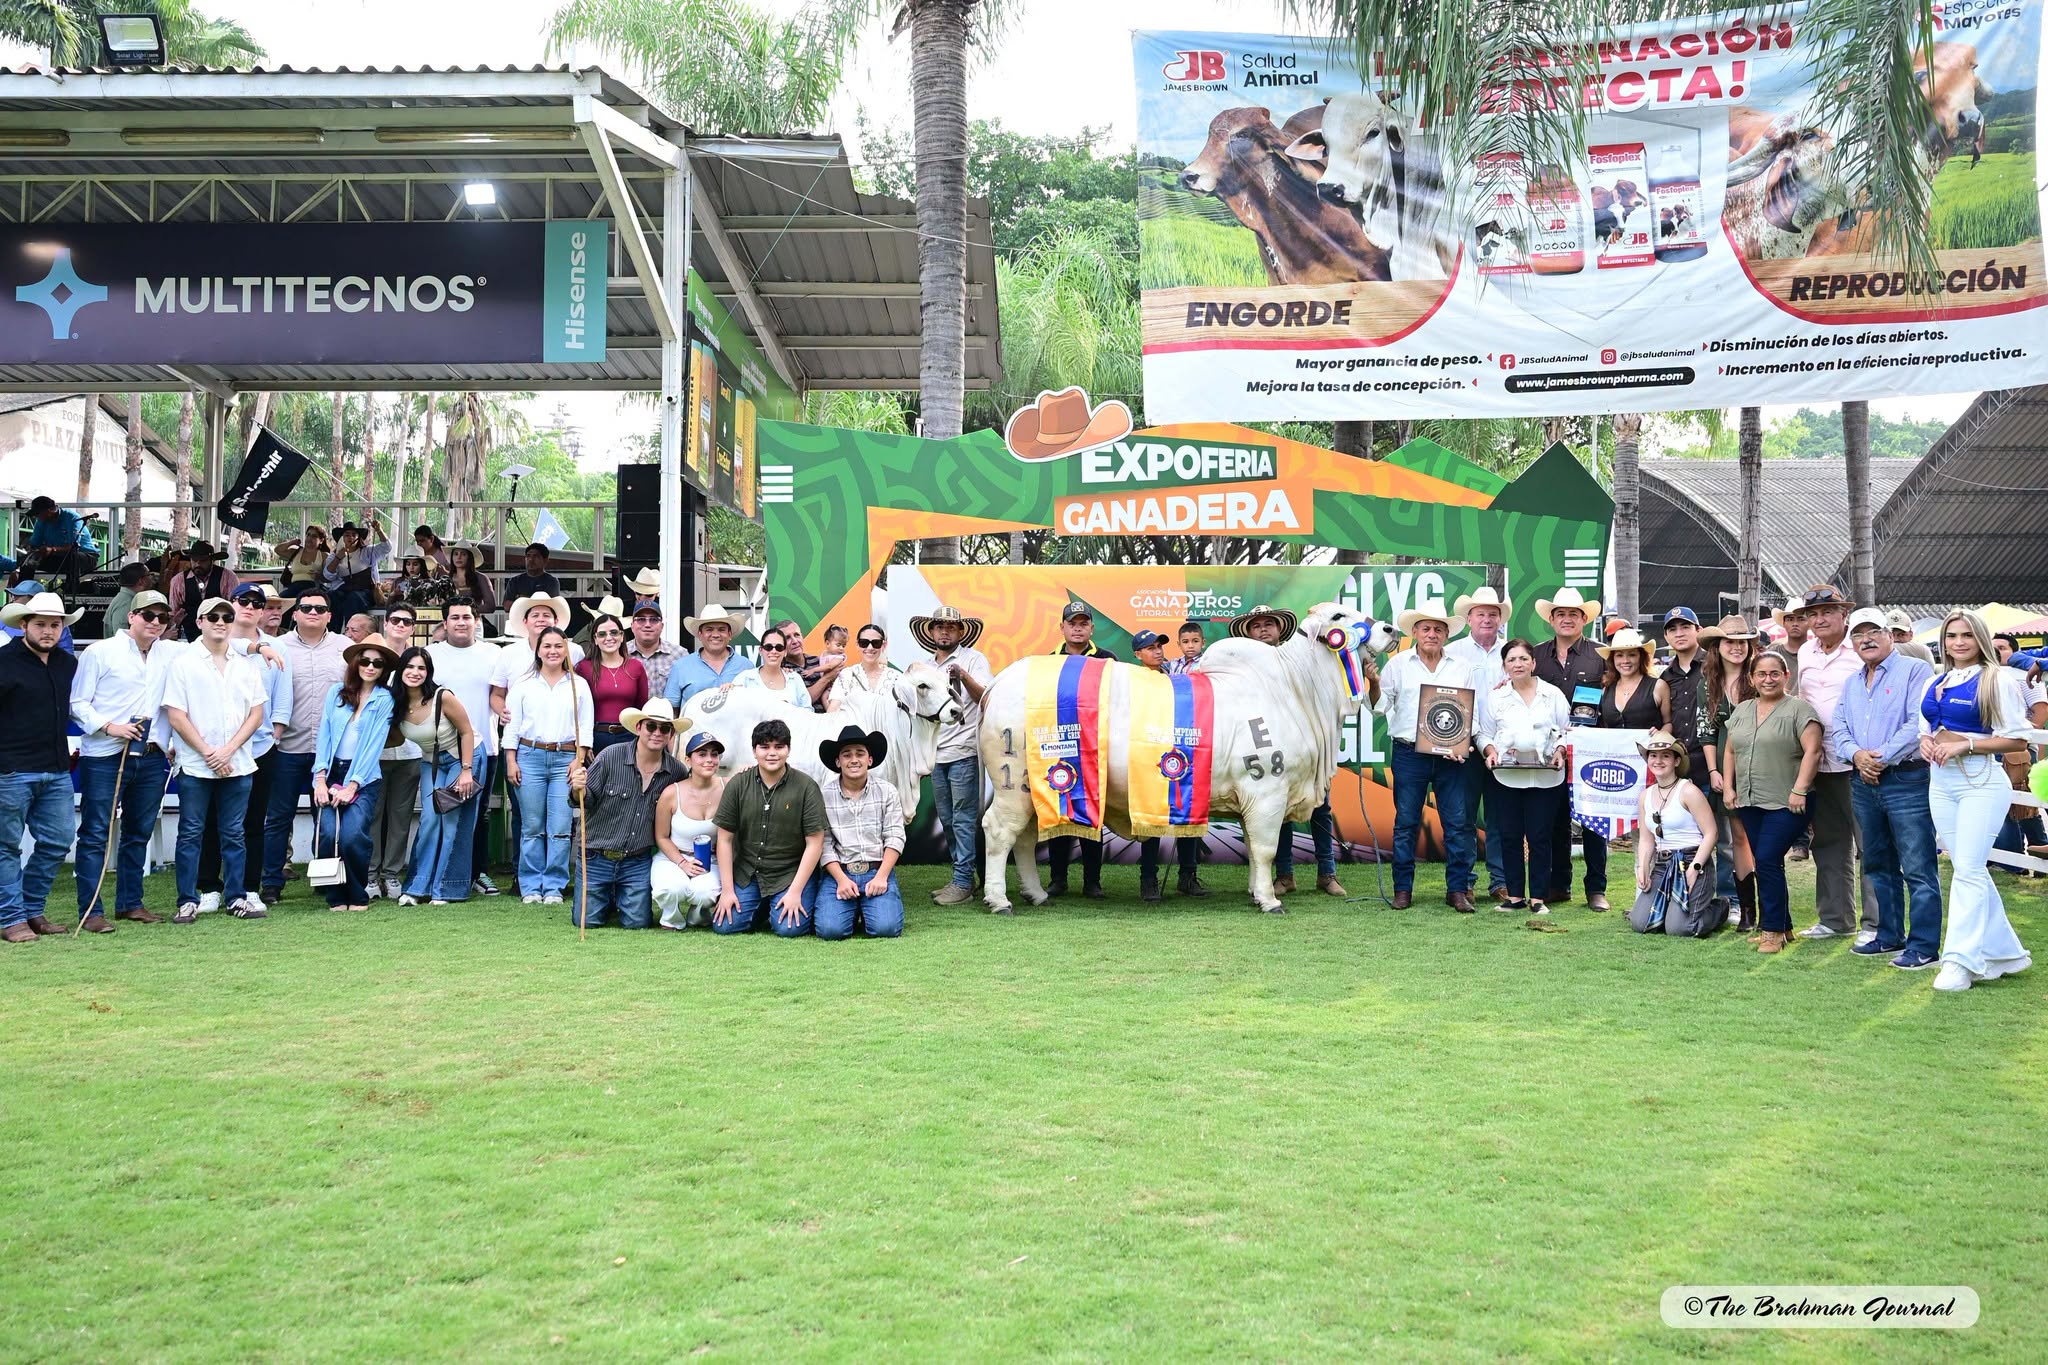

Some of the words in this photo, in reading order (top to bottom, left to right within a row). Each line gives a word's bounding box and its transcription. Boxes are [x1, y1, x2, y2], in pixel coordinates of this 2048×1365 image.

[1944, 7, 2021, 30] Mayores
[1242, 53, 1296, 68] Salud
[1244, 70, 1318, 87] Animal
[1590, 152, 1641, 164] Fosfoplex
[1656, 186, 1694, 194] Fosfoplex
[1628, 232, 1648, 245] JB
[1789, 259, 2027, 301] REPRODUCCIÓN
[565, 232, 586, 349] Hisense
[1185, 300, 1352, 328] ENGORDE
[1710, 335, 1808, 352] Disminución
[1811, 335, 1829, 347] de
[1832, 334, 1853, 346] los
[1856, 332, 1886, 345] días
[1889, 329, 1948, 342] abiertos.
[1296, 358, 1344, 372] Mayor
[1346, 356, 1418, 371] ganancia
[1420, 355, 1439, 367] de
[1441, 355, 1482, 369] peso.
[1519, 354, 1588, 364] JBSaludAnimal
[1620, 349, 1695, 362] @jbsaludanimal
[1725, 360, 1814, 376] Incremento
[1817, 361, 1834, 371] en
[1837, 358, 1851, 370] la
[1853, 353, 1920, 369] eficiencia
[1922, 347, 2027, 368] reproductiva.
[1246, 380, 1298, 395] Mejora
[1300, 381, 1314, 392] la
[1317, 382, 1350, 392] tasa
[1352, 380, 1371, 392] de
[1373, 378, 1466, 393] concepción.
[1516, 372, 1684, 389] www.jamesbrownpharma.com
[1081, 442, 1274, 483] EXPOFERIA
[1063, 489, 1300, 533] GANADERA
[1130, 591, 1242, 608] GANADEROS
[1136, 609, 1172, 617] LITORAL
[1174, 609, 1180, 617] Y
[1182, 608, 1236, 617] GALÁPAGOS
[1248, 717, 1272, 749] E
[1242, 750, 1284, 781] 58
[1592, 768, 1625, 785] ABBA
